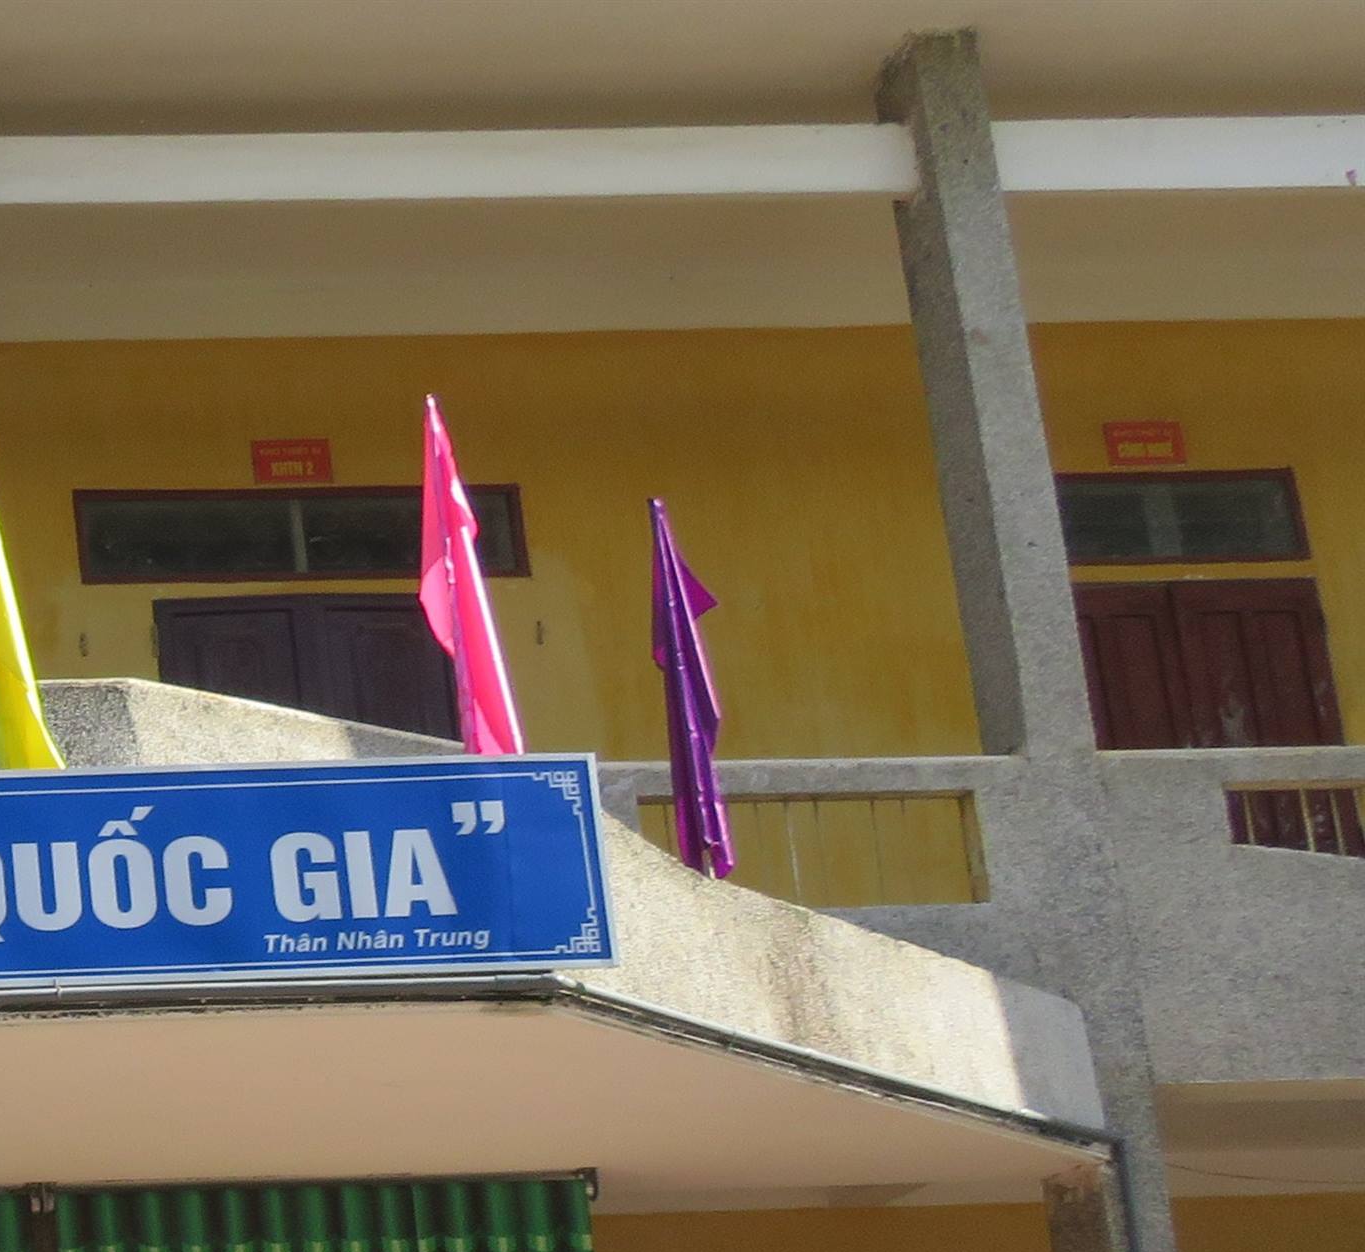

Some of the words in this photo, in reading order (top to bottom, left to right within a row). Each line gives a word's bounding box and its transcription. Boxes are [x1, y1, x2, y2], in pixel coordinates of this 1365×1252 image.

[263, 933, 328, 953] Thân
[337, 930, 404, 950] Nhân
[414, 927, 491, 949] Trung
